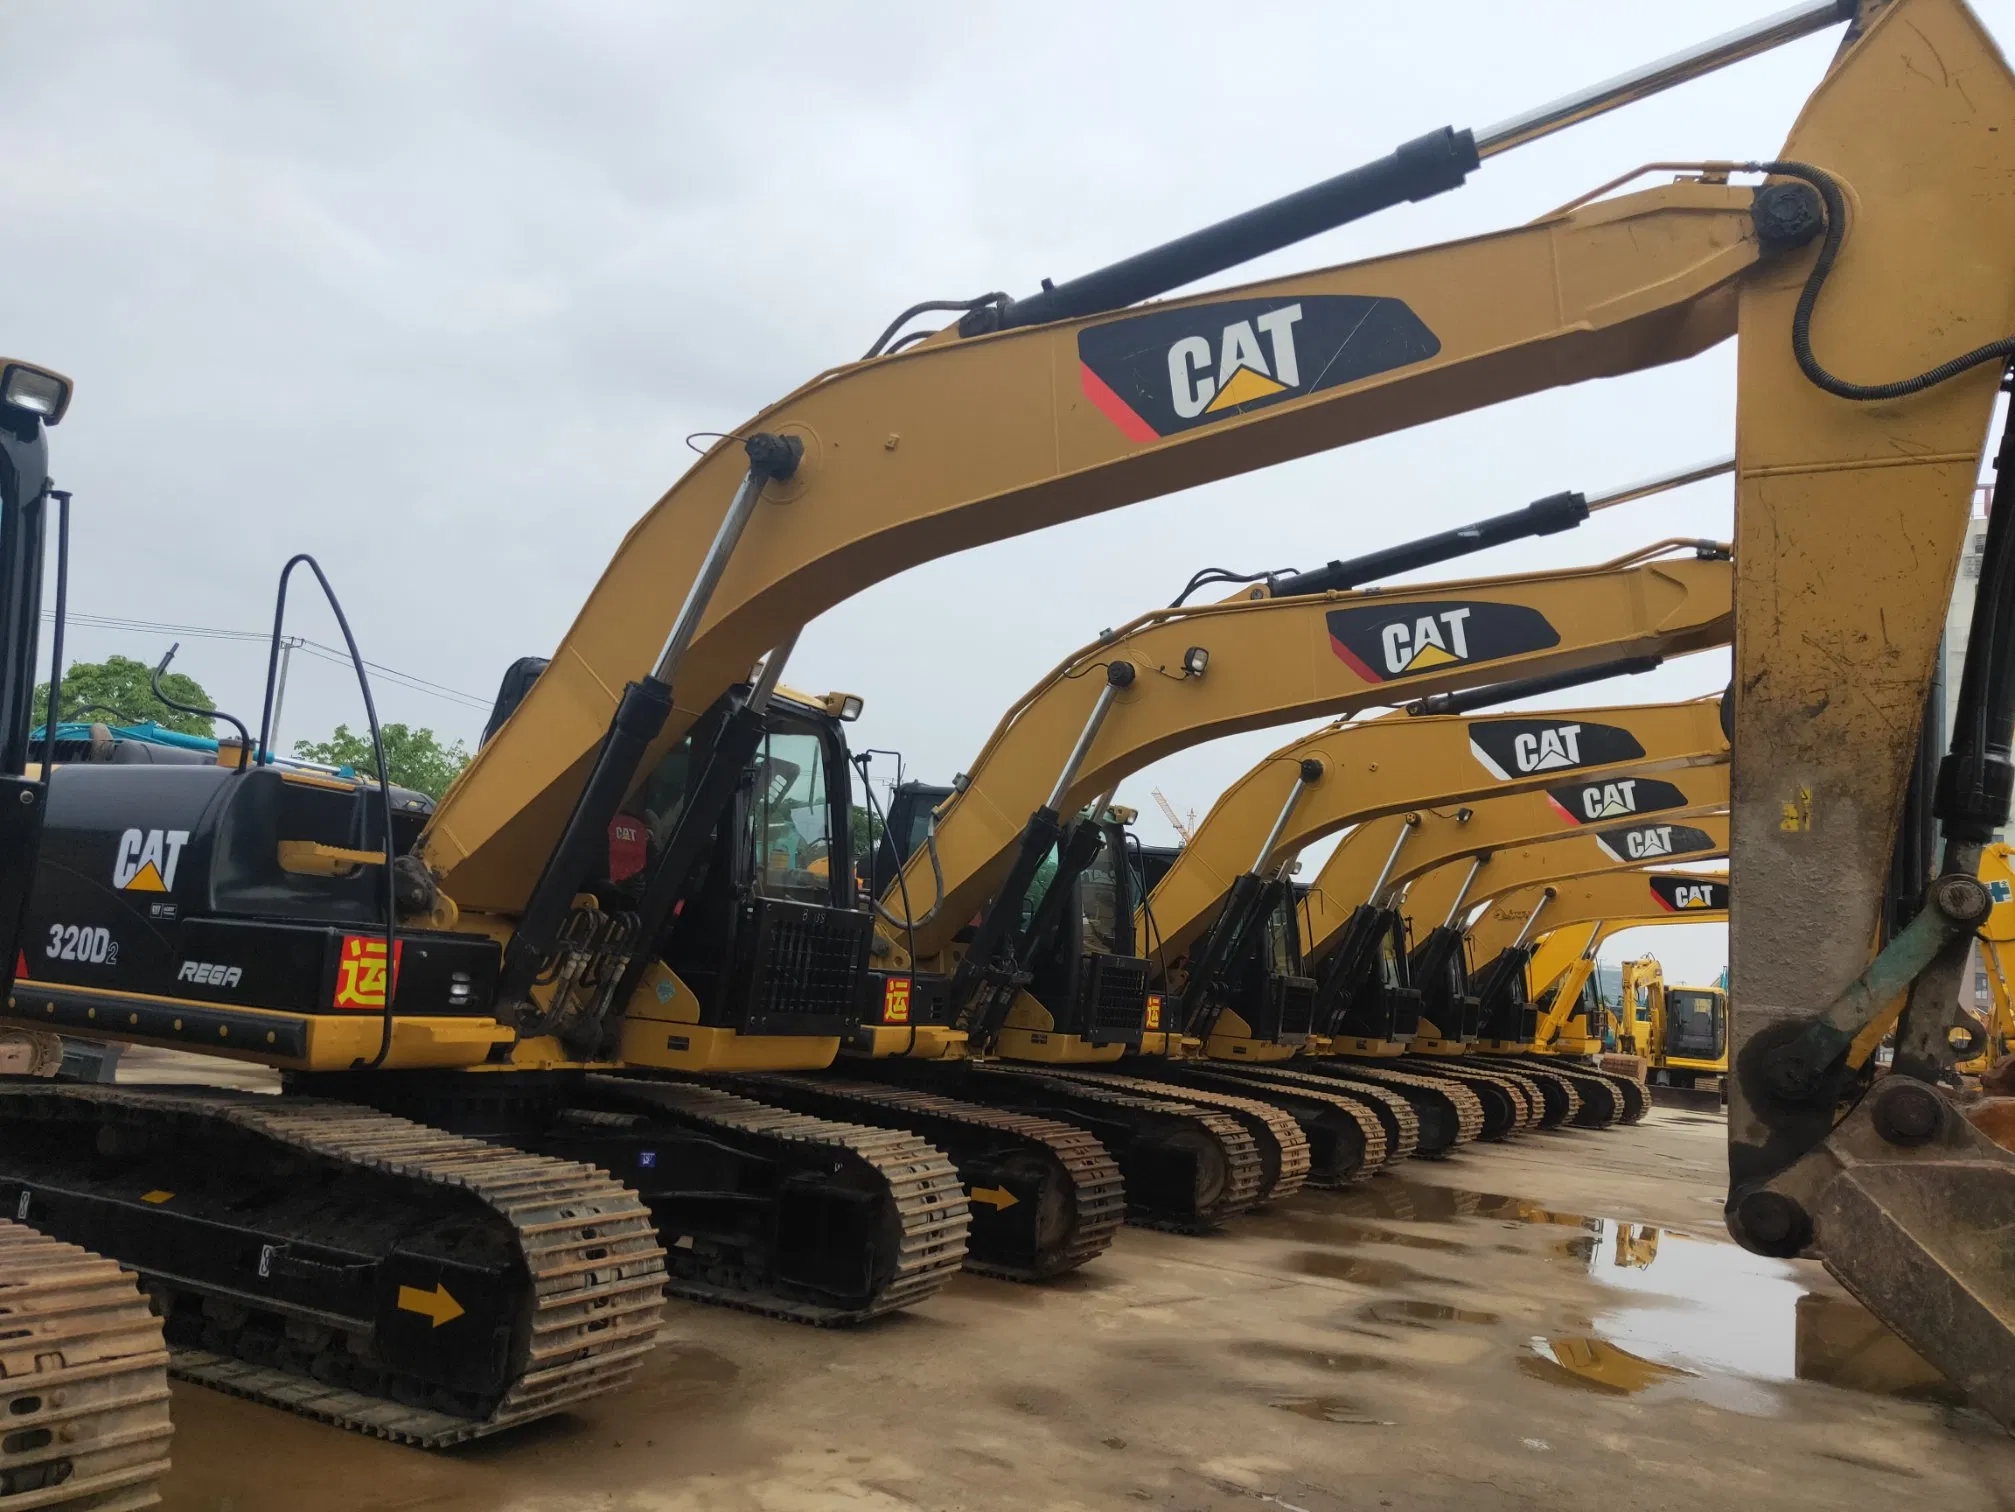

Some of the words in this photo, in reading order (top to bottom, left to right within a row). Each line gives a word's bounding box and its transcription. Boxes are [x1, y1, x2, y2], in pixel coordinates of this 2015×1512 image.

[1168, 303, 1303, 419] CAT
[1381, 608, 1471, 674] CAT
[1514, 724, 1582, 772] CAT
[1582, 780, 1636, 819] CAT
[615, 826, 637, 841] CAT
[1626, 826, 1673, 859] CAT
[113, 828, 190, 892] CAT
[1674, 885, 1713, 908] CAT
[177, 960, 243, 988] REGA
[337, 939, 397, 1006] 运
[885, 980, 909, 1021] 运
[1146, 996, 1160, 1028] 运
